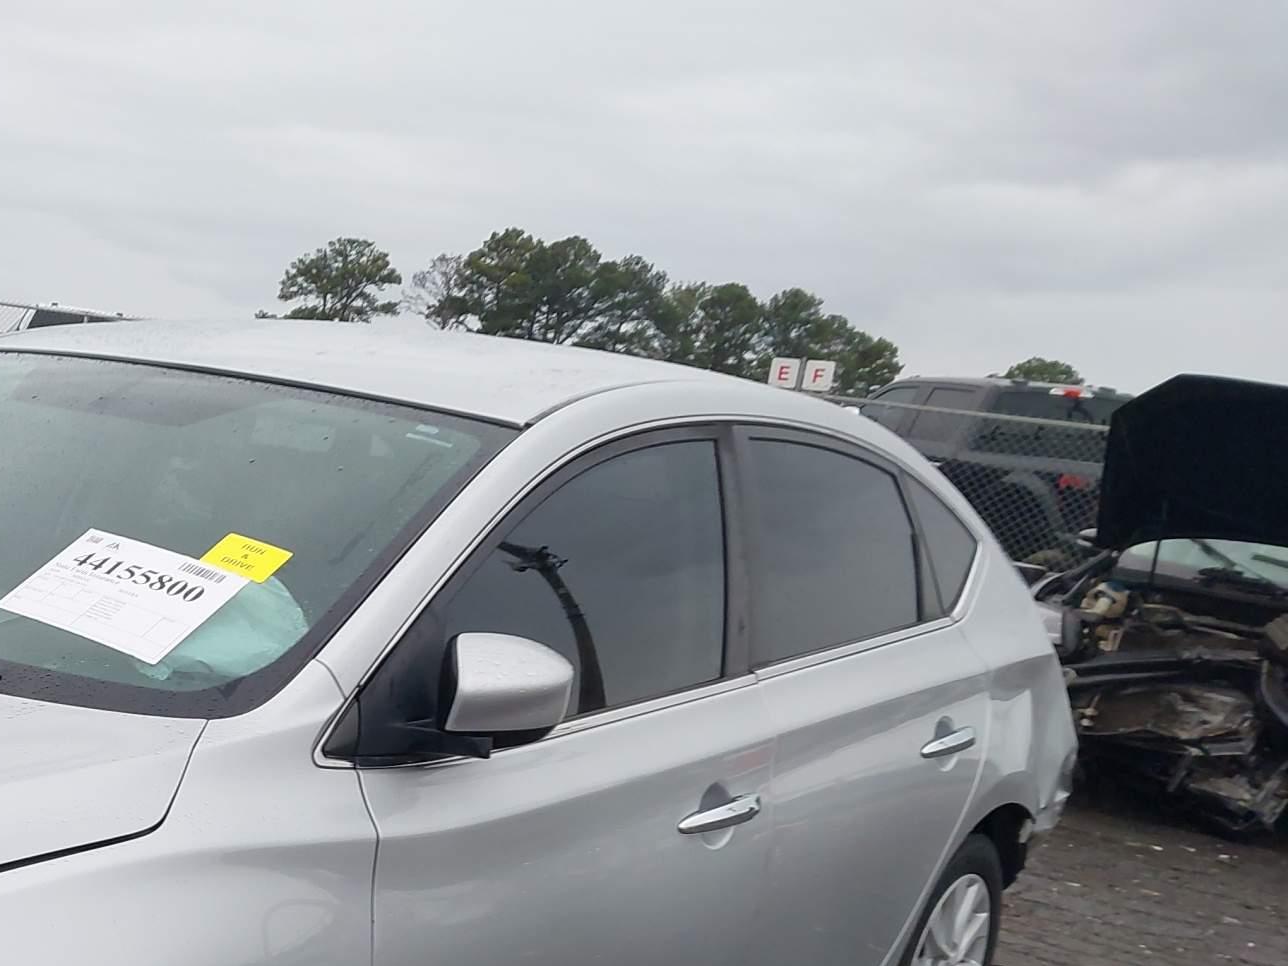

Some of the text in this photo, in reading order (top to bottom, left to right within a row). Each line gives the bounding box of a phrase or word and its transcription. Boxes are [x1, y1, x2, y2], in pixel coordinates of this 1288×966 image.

[778, 365, 791, 381] E
[812, 368, 826, 384] F
[242, 543, 266, 556] RUN
[220, 556, 255, 571] DRIVE
[73, 552, 205, 602] 44155800
